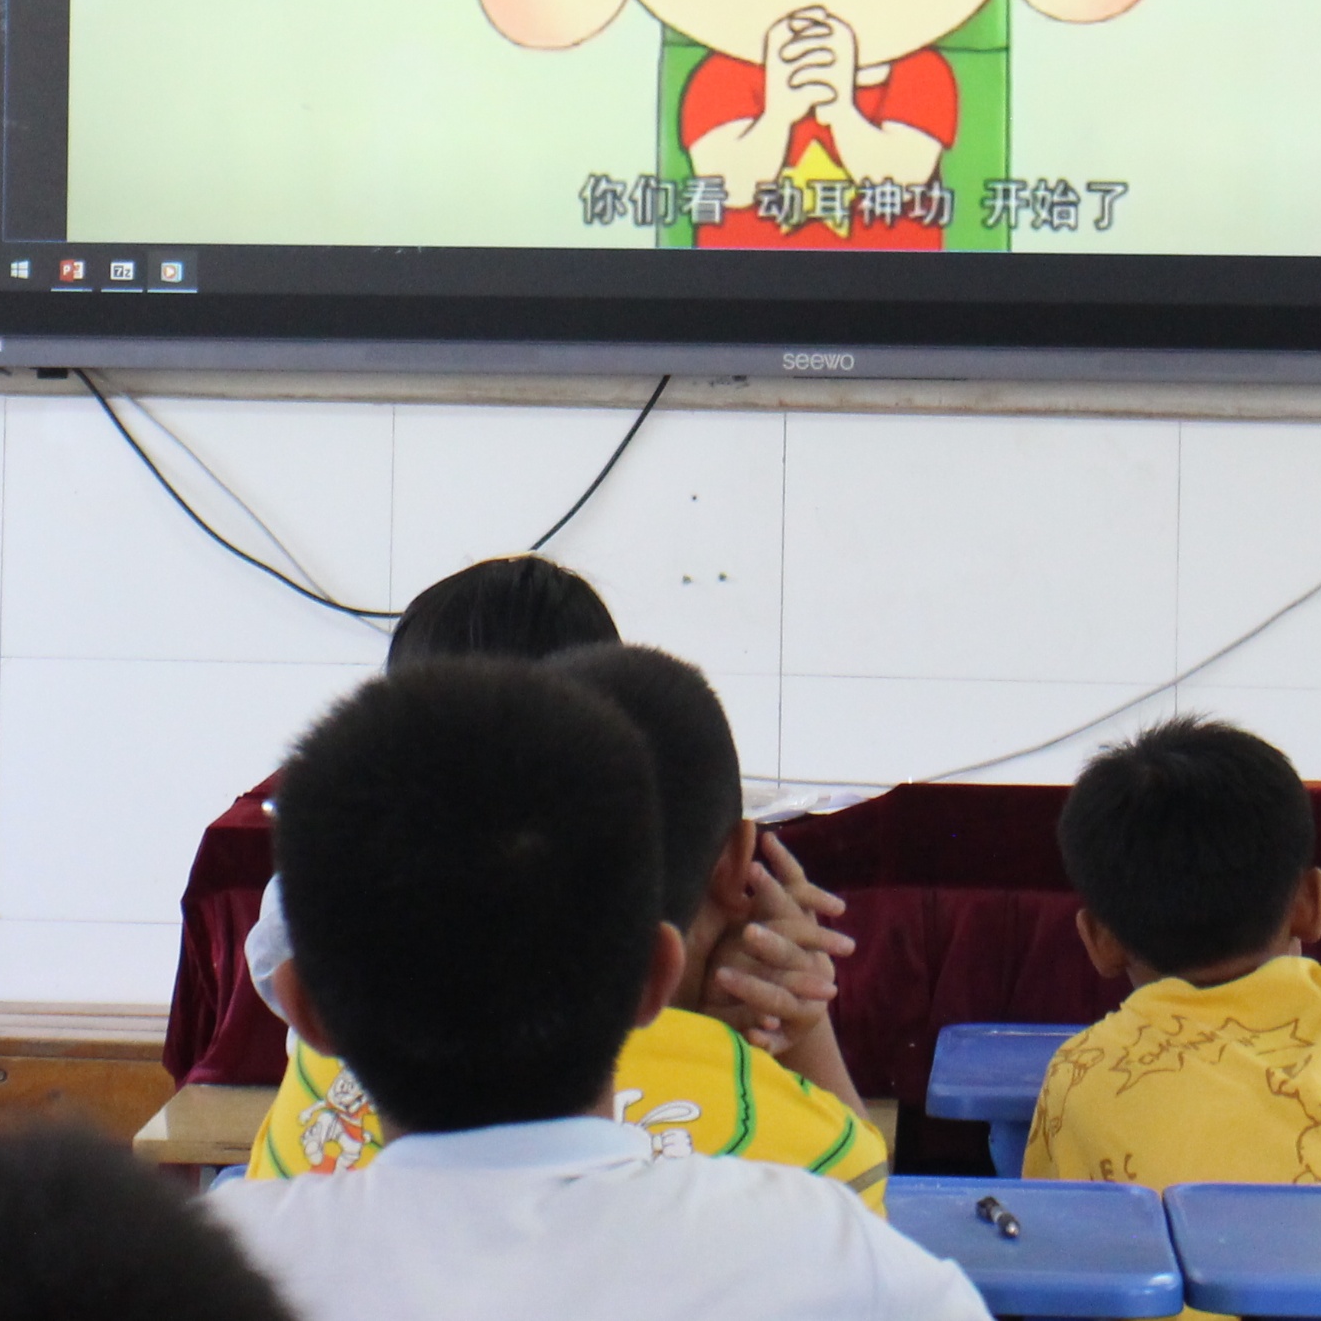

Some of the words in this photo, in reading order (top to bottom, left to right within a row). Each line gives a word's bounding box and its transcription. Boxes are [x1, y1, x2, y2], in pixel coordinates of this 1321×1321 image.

[579, 174, 728, 227] 你们看
[755, 176, 954, 229] 动耳神功
[983, 179, 1129, 231] 开始了
[782, 352, 855, 371] seewo
